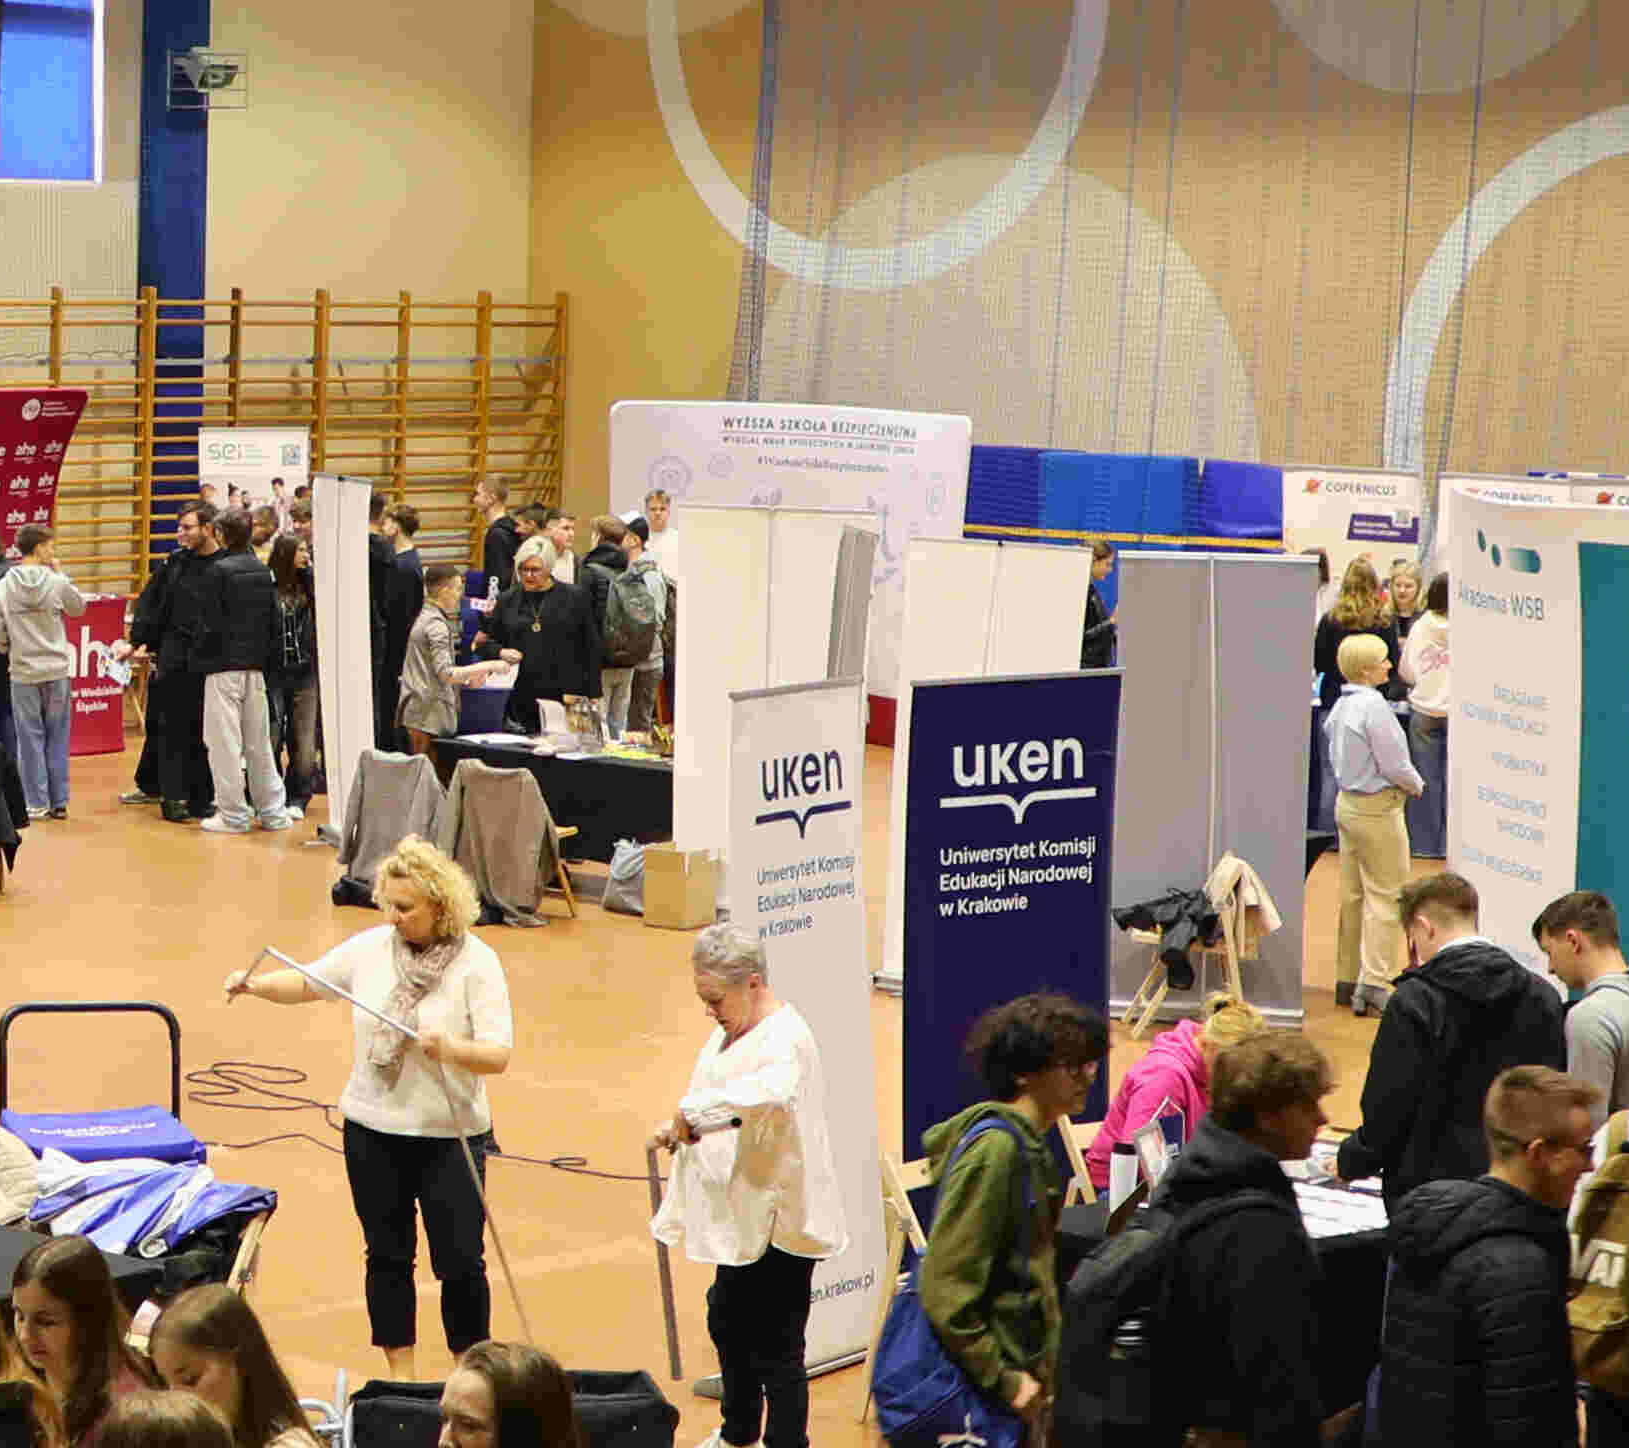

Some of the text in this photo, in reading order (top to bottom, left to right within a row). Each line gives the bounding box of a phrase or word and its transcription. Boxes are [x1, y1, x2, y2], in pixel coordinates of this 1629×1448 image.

[721, 415, 918, 440] WYŻSZA SZKOŁA BEZPIECZEŃSTWA
[14, 442, 38, 457] ahe
[43, 440, 64, 454] ahe
[9, 475, 30, 491] ahe
[1324, 481, 1398, 498] COPERNICUS
[5, 509, 27, 524] ahe
[1458, 580, 1544, 622] Akademia WSB
[761, 749, 843, 802] uken
[952, 736, 1085, 788] uken
[939, 836, 1096, 867] Uniwersytet Komisji
[756, 858, 816, 887] Uniwersytet
[939, 862, 1093, 893] Edukacji Narodowej
[757, 879, 856, 914] Edukacji Narodowej
[939, 892, 1028, 917] w Krakowie
[768, 913, 814, 938] Krakowie
